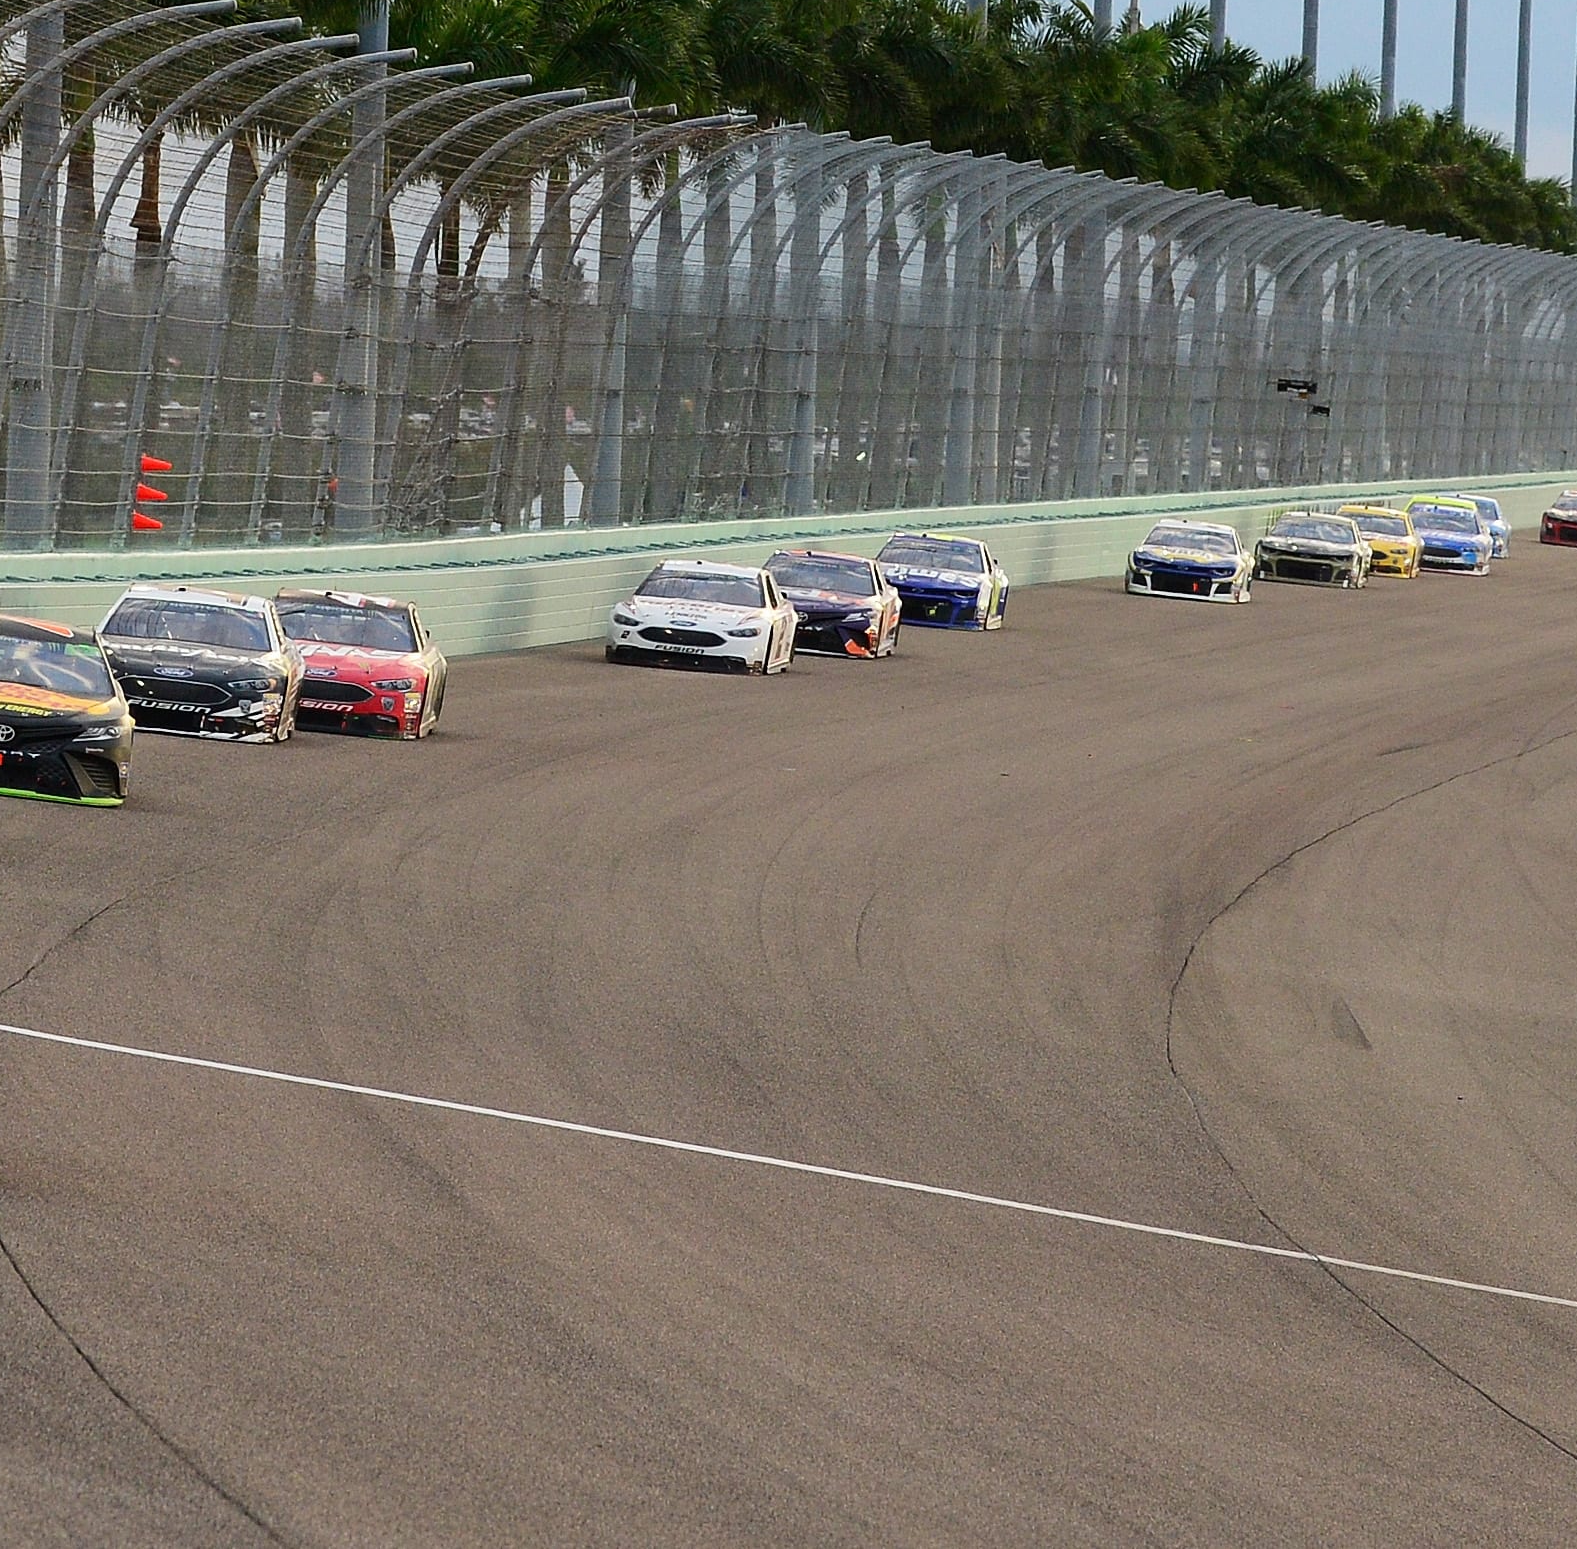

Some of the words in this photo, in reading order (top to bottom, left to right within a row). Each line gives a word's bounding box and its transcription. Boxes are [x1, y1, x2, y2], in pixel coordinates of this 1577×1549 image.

[620, 630, 631, 639] 2
[654, 644, 705, 655] FUSION
[5, 703, 53, 717] ENERGY
[127, 699, 212, 714] FUSION
[299, 700, 354, 712] SION
